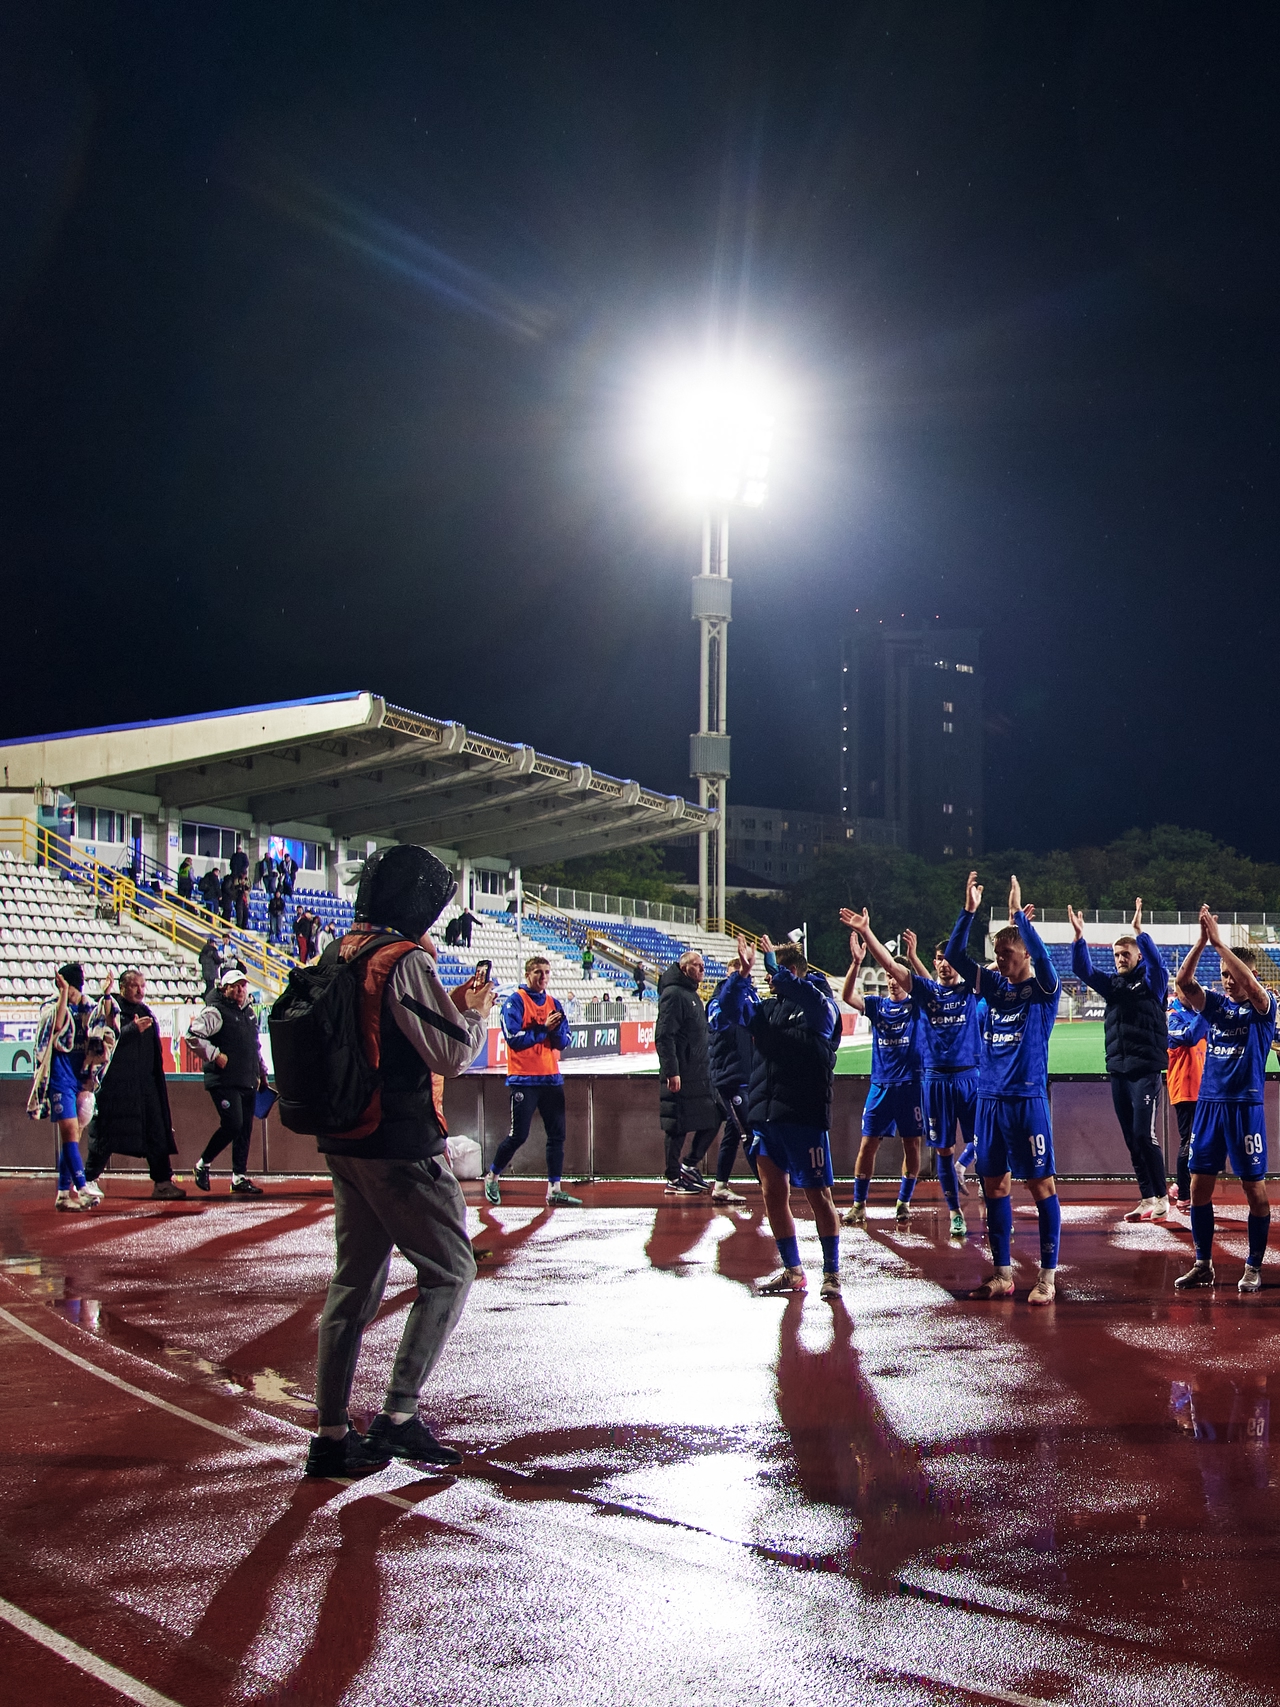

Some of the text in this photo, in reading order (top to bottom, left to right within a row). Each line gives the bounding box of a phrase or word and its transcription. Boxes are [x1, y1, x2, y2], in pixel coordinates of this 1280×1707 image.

[594, 1028, 617, 1047] PARI
[1222, 1027, 1249, 1038] ДЕЛО
[1028, 1133, 1046, 1157] 19
[1244, 1133, 1263, 1155] 69
[808, 1146, 825, 1169] 10
